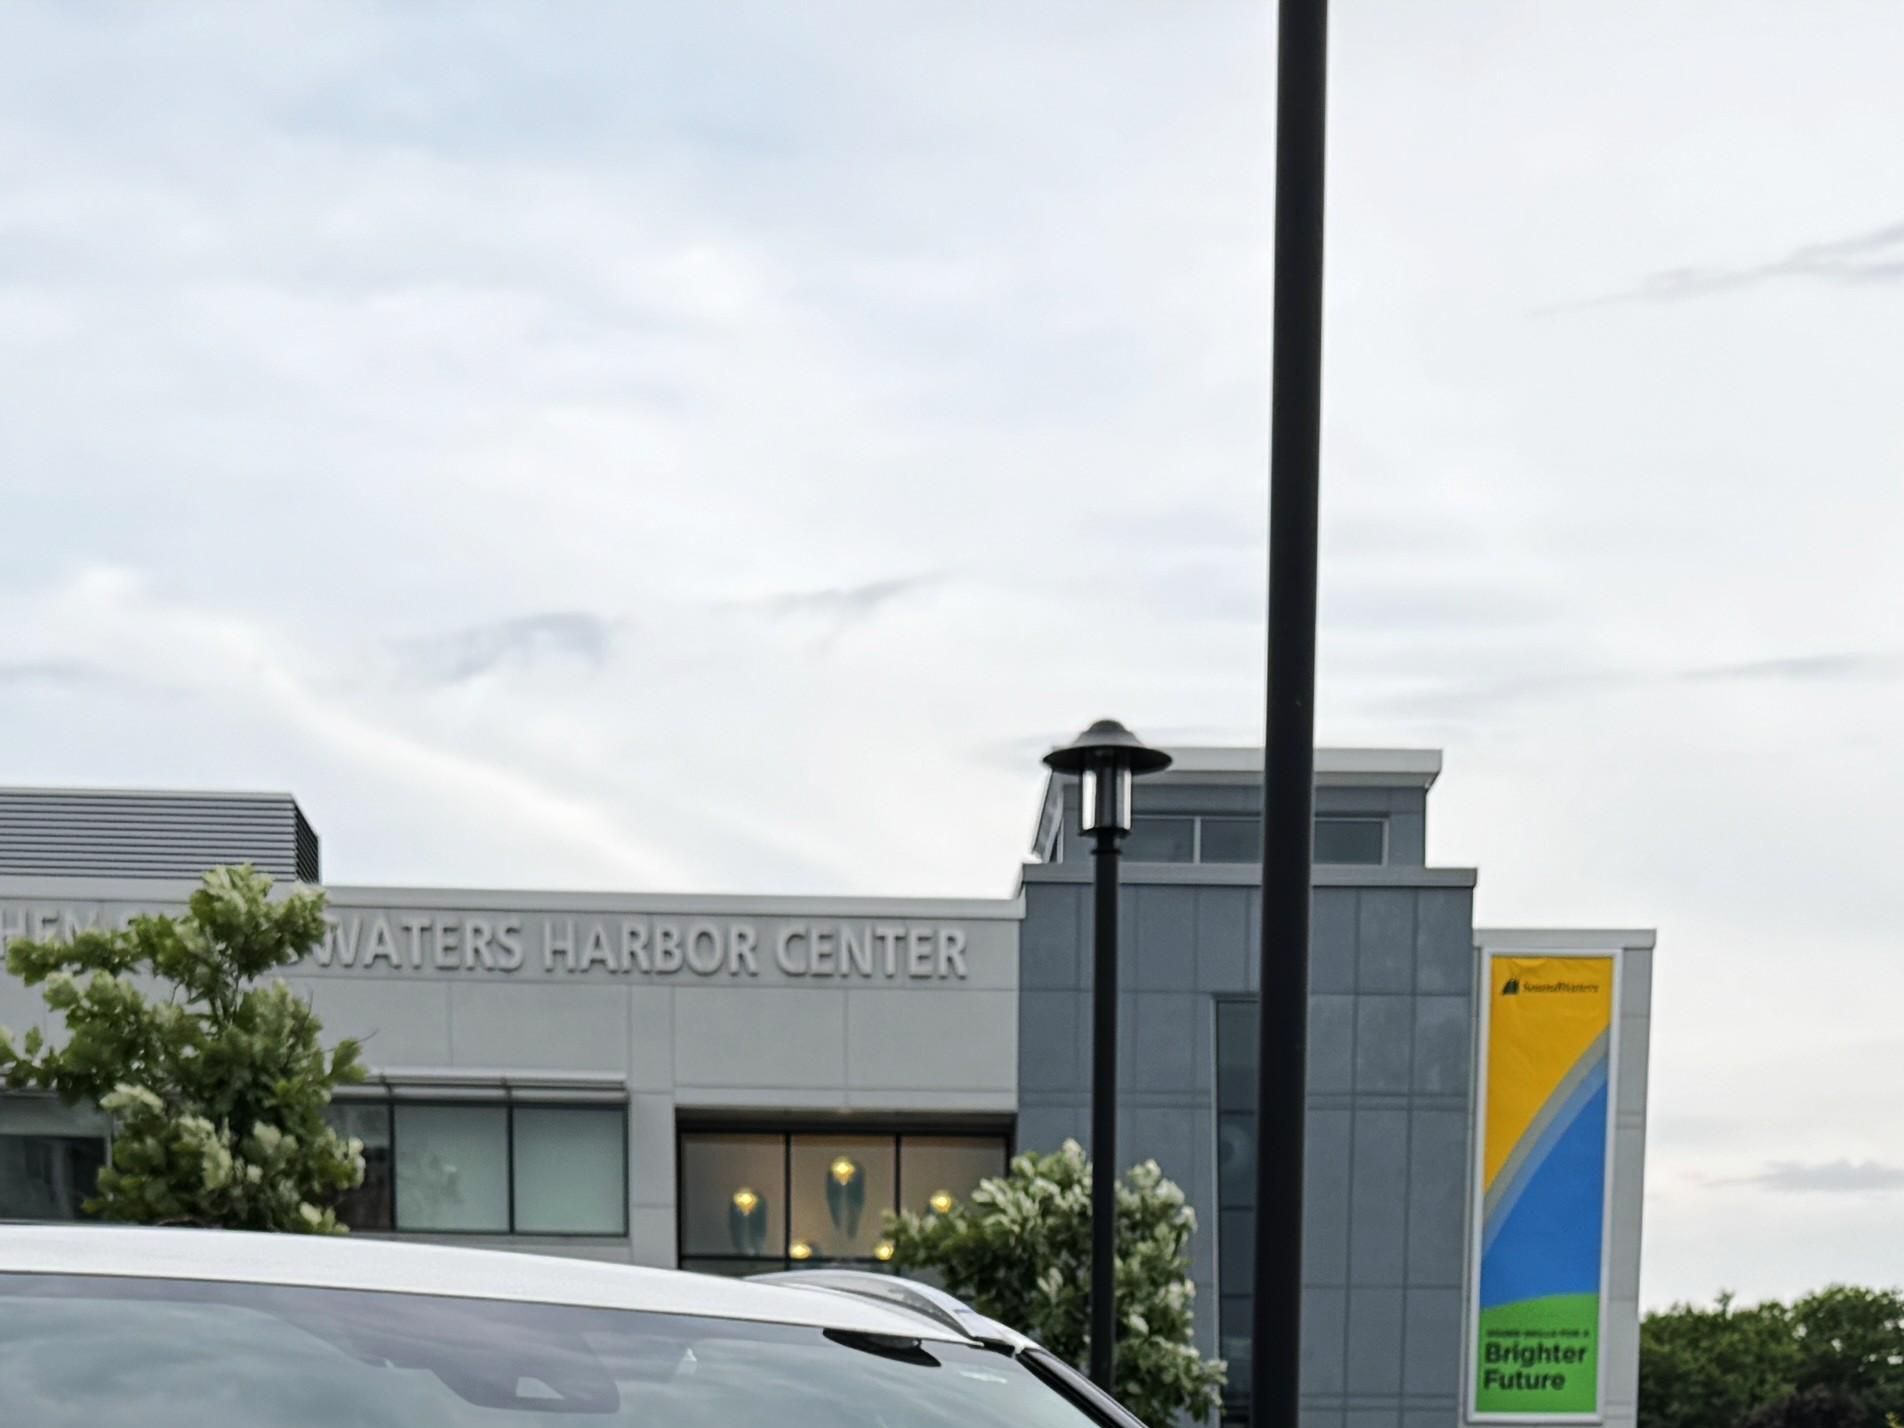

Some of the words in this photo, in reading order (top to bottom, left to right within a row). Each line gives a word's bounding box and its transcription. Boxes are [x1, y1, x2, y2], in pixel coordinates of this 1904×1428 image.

[544, 917, 760, 977] HARBOR
[775, 922, 969, 981] CENTER
[1485, 1341, 1587, 1368] Brighter
[1483, 1368, 1566, 1391] Future
